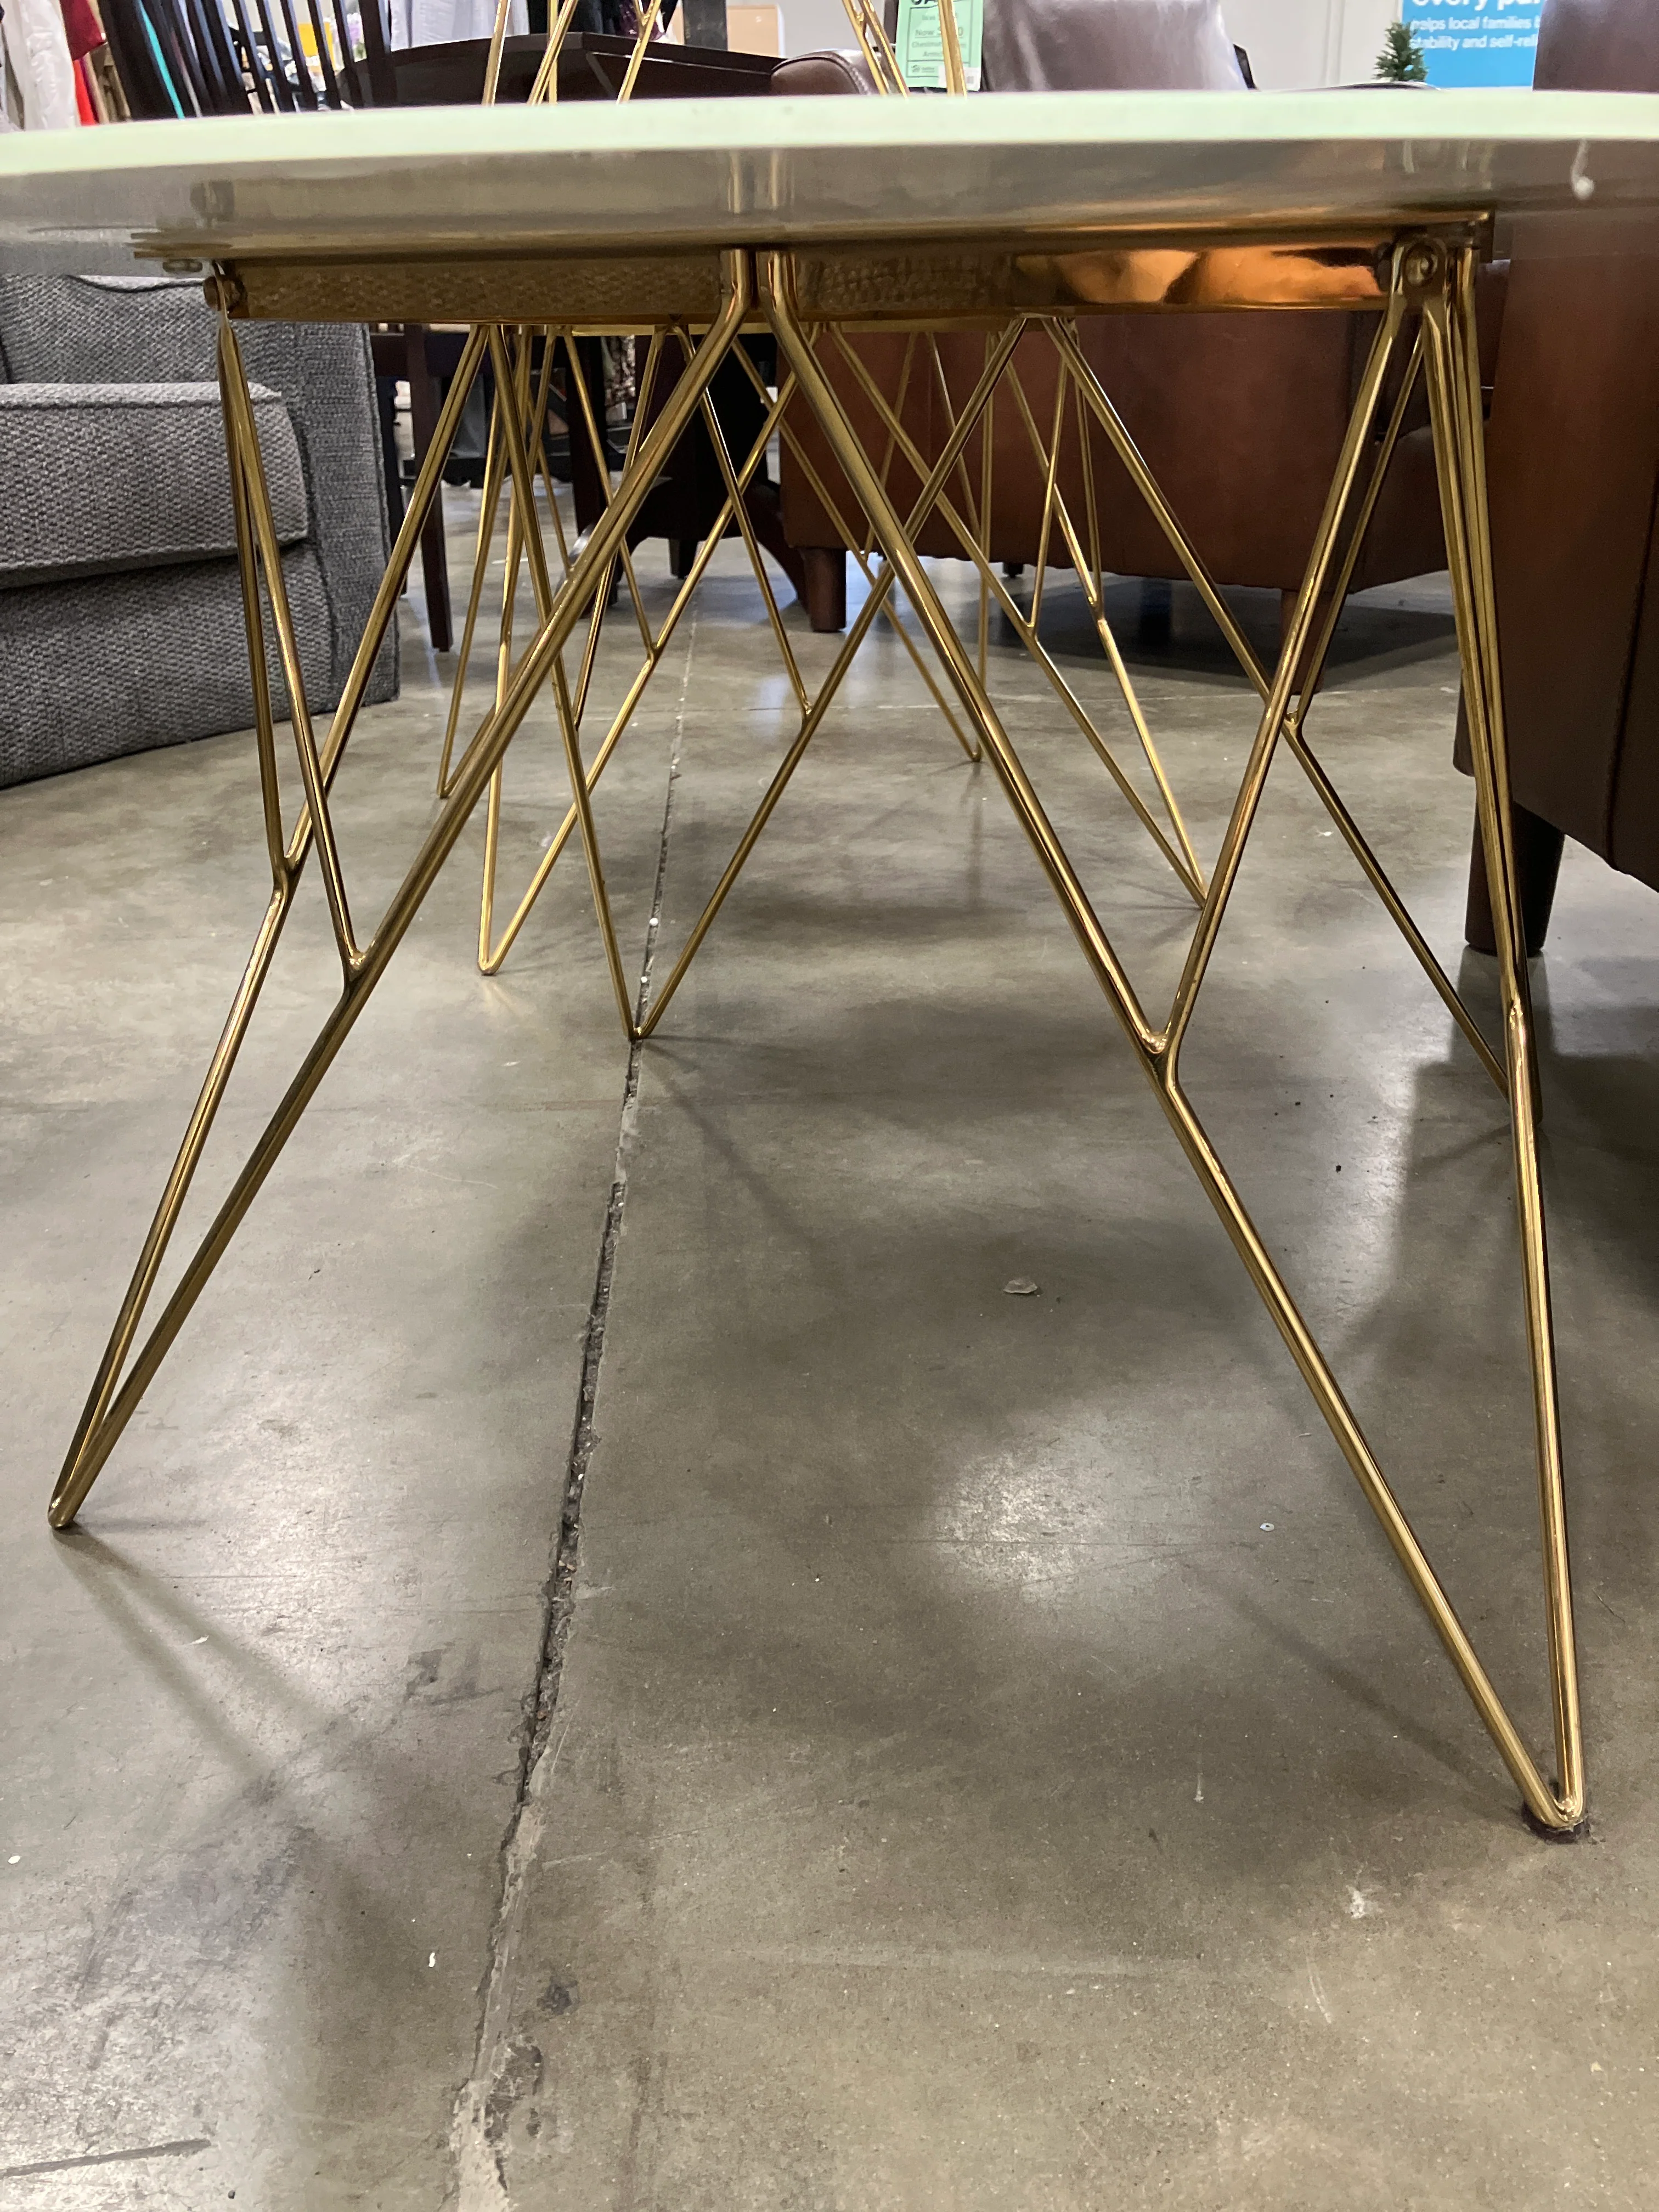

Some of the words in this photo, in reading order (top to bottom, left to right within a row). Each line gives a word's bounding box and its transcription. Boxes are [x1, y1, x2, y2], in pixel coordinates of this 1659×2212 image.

[1448, 16, 1480, 29] local
[1482, 15, 1532, 29] families
[1462, 35, 1487, 48] and
